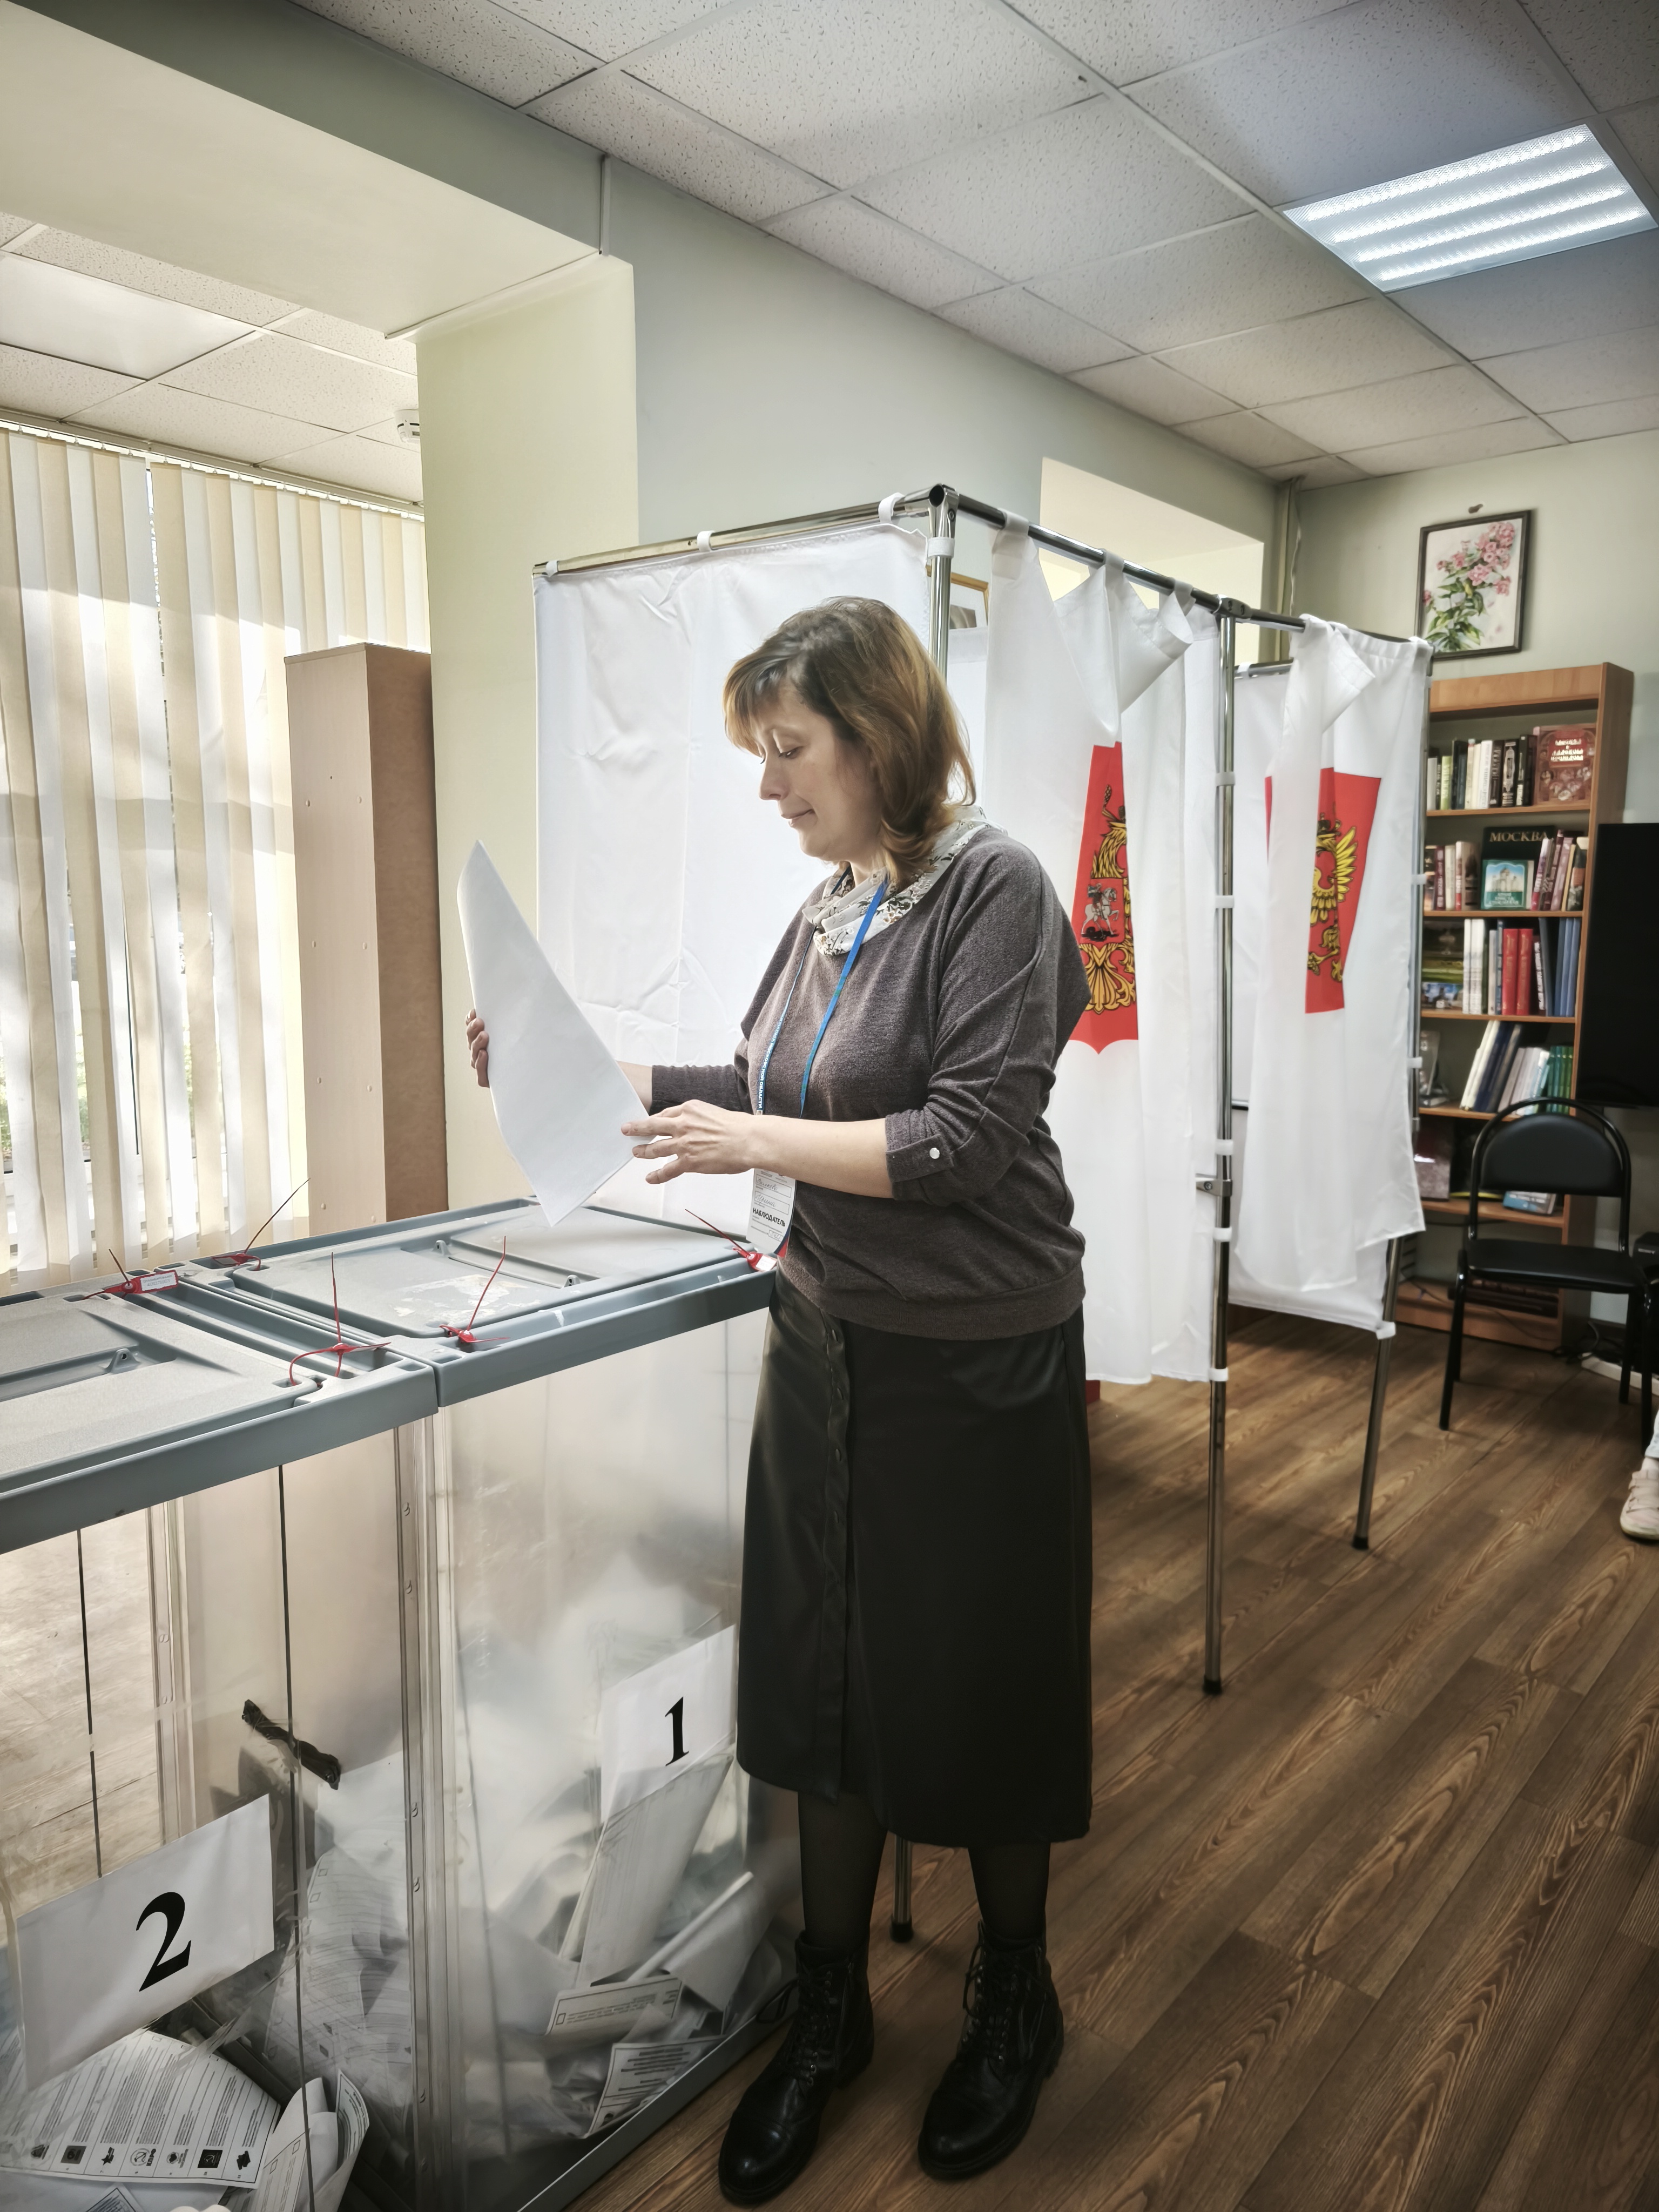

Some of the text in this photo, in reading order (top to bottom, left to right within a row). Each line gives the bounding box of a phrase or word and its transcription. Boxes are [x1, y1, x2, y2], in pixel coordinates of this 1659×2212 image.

[1489, 831, 1548, 842] МОСКВА
[752, 1207, 786, 1227] НАБЛЮДАТЕЛЬ
[664, 1696, 690, 1767] 1
[136, 1892, 192, 1992] 2
